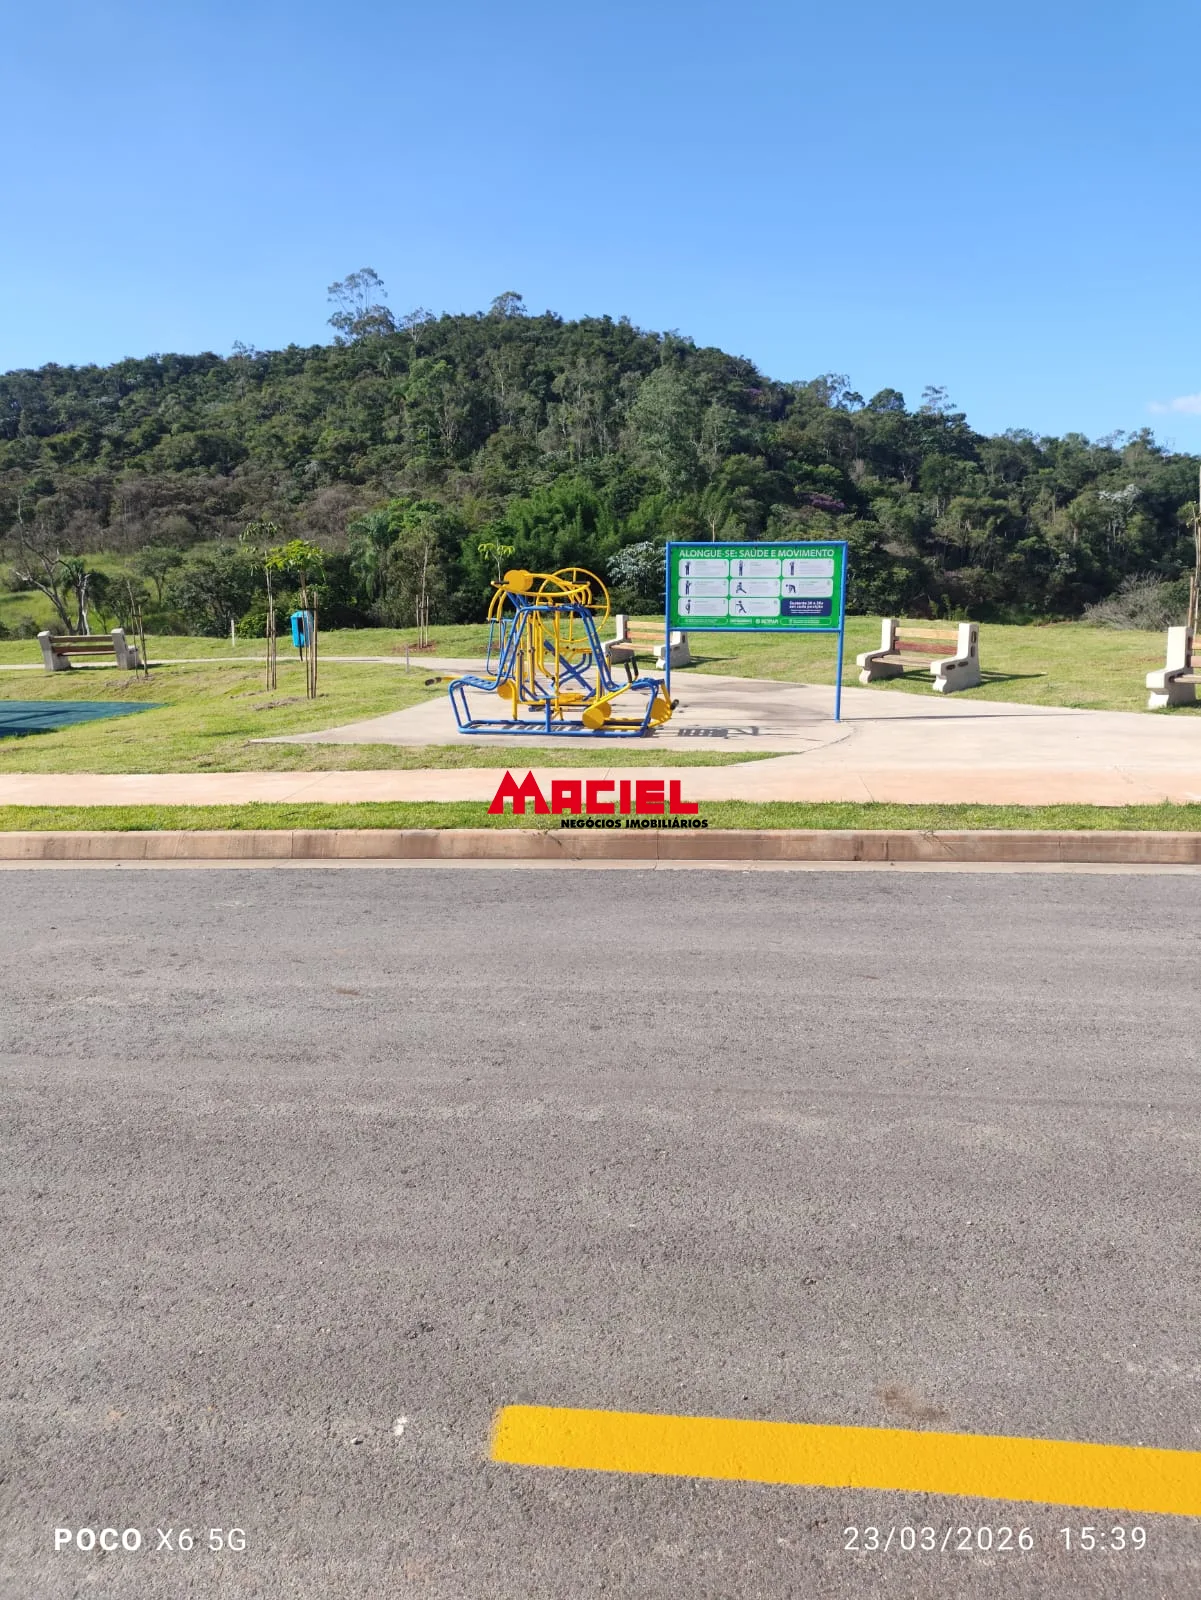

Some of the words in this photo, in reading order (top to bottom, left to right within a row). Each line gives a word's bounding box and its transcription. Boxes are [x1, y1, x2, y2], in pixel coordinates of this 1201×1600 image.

[679, 549, 738, 558] ALONGUE-SE:
[739, 547, 769, 558] SAÚDE
[771, 549, 777, 557] E
[778, 549, 835, 557] MOVIMENTO
